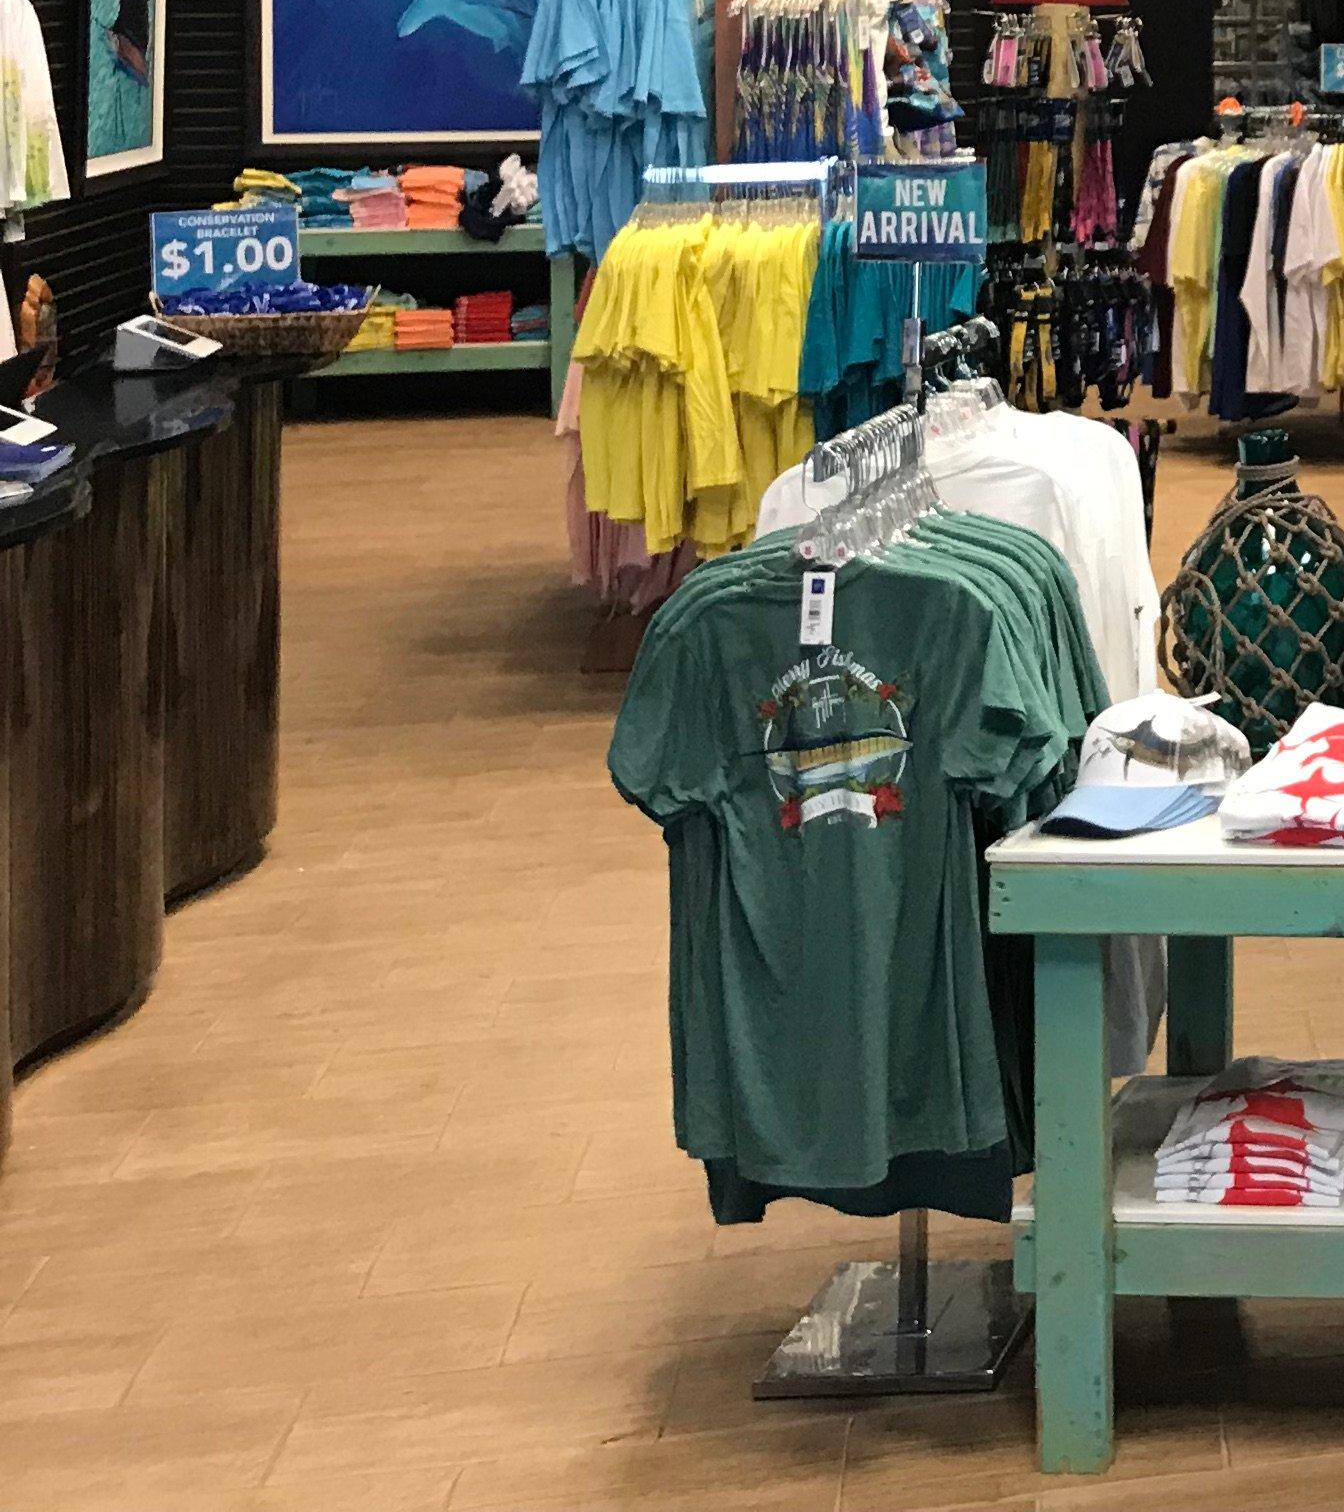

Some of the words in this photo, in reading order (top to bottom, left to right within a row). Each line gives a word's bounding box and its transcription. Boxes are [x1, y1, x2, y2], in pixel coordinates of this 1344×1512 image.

[894, 178, 947, 207] NEW
[178, 212, 275, 228] CONSERVATION
[197, 225, 259, 239] BRACELET
[860, 210, 984, 245] ARRIVAL
[161, 235, 293, 280] $1.00
